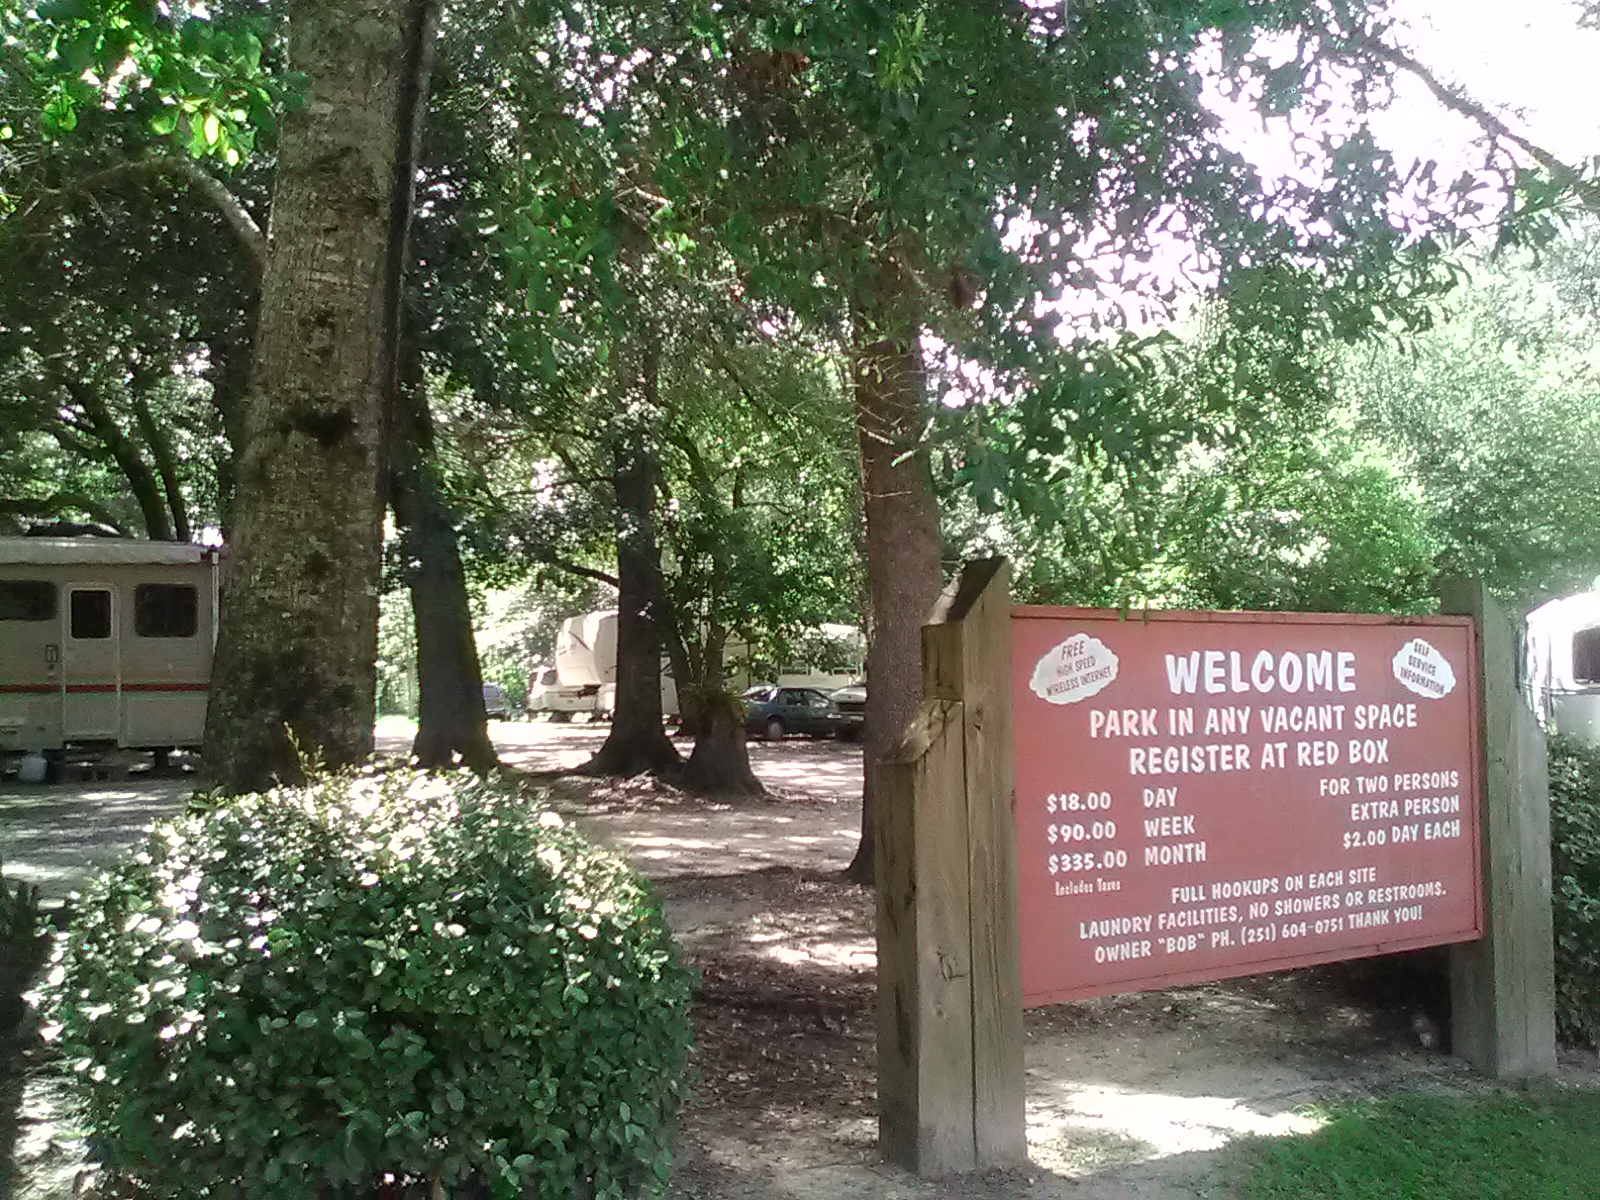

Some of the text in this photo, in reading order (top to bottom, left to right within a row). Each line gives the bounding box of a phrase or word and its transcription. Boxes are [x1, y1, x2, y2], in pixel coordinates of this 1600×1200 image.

[1061, 640, 1085, 660] FREE
[1075, 656, 1096, 673] SPEED
[1408, 655, 1437, 675] SERVICE
[1046, 666, 1113, 697] WIRELESS INTERNET
[1165, 650, 1356, 694] WELCOME
[1399, 667, 1445, 695] INFORMATION
[1090, 704, 1417, 738] PARK IN ANY VACANT SPACE
[1129, 738, 1389, 775] REGISTER AT RED BOX
[1320, 771, 1459, 796] FOR TWO PERSONS
[1047, 787, 1178, 814] $18.00 DAY
[1351, 795, 1460, 821] EXTRA PERSON
[1047, 815, 1195, 845] $90.00 WEEK
[1343, 819, 1460, 850] $2.00 DAY EACH
[1048, 841, 1207, 876] $335.00 MONTH
[1055, 878, 1121, 897] Includes Taxes
[1171, 867, 1376, 904] FULL HOOKUPS ON EACH SITE
[1079, 881, 1447, 940] LAUNDRY FACILITIES, NO SHOWERS OR RESTROOMS.
[1094, 905, 1423, 964] OWNER "BOB" PH. (251) 604-0751 THANK YOU!
